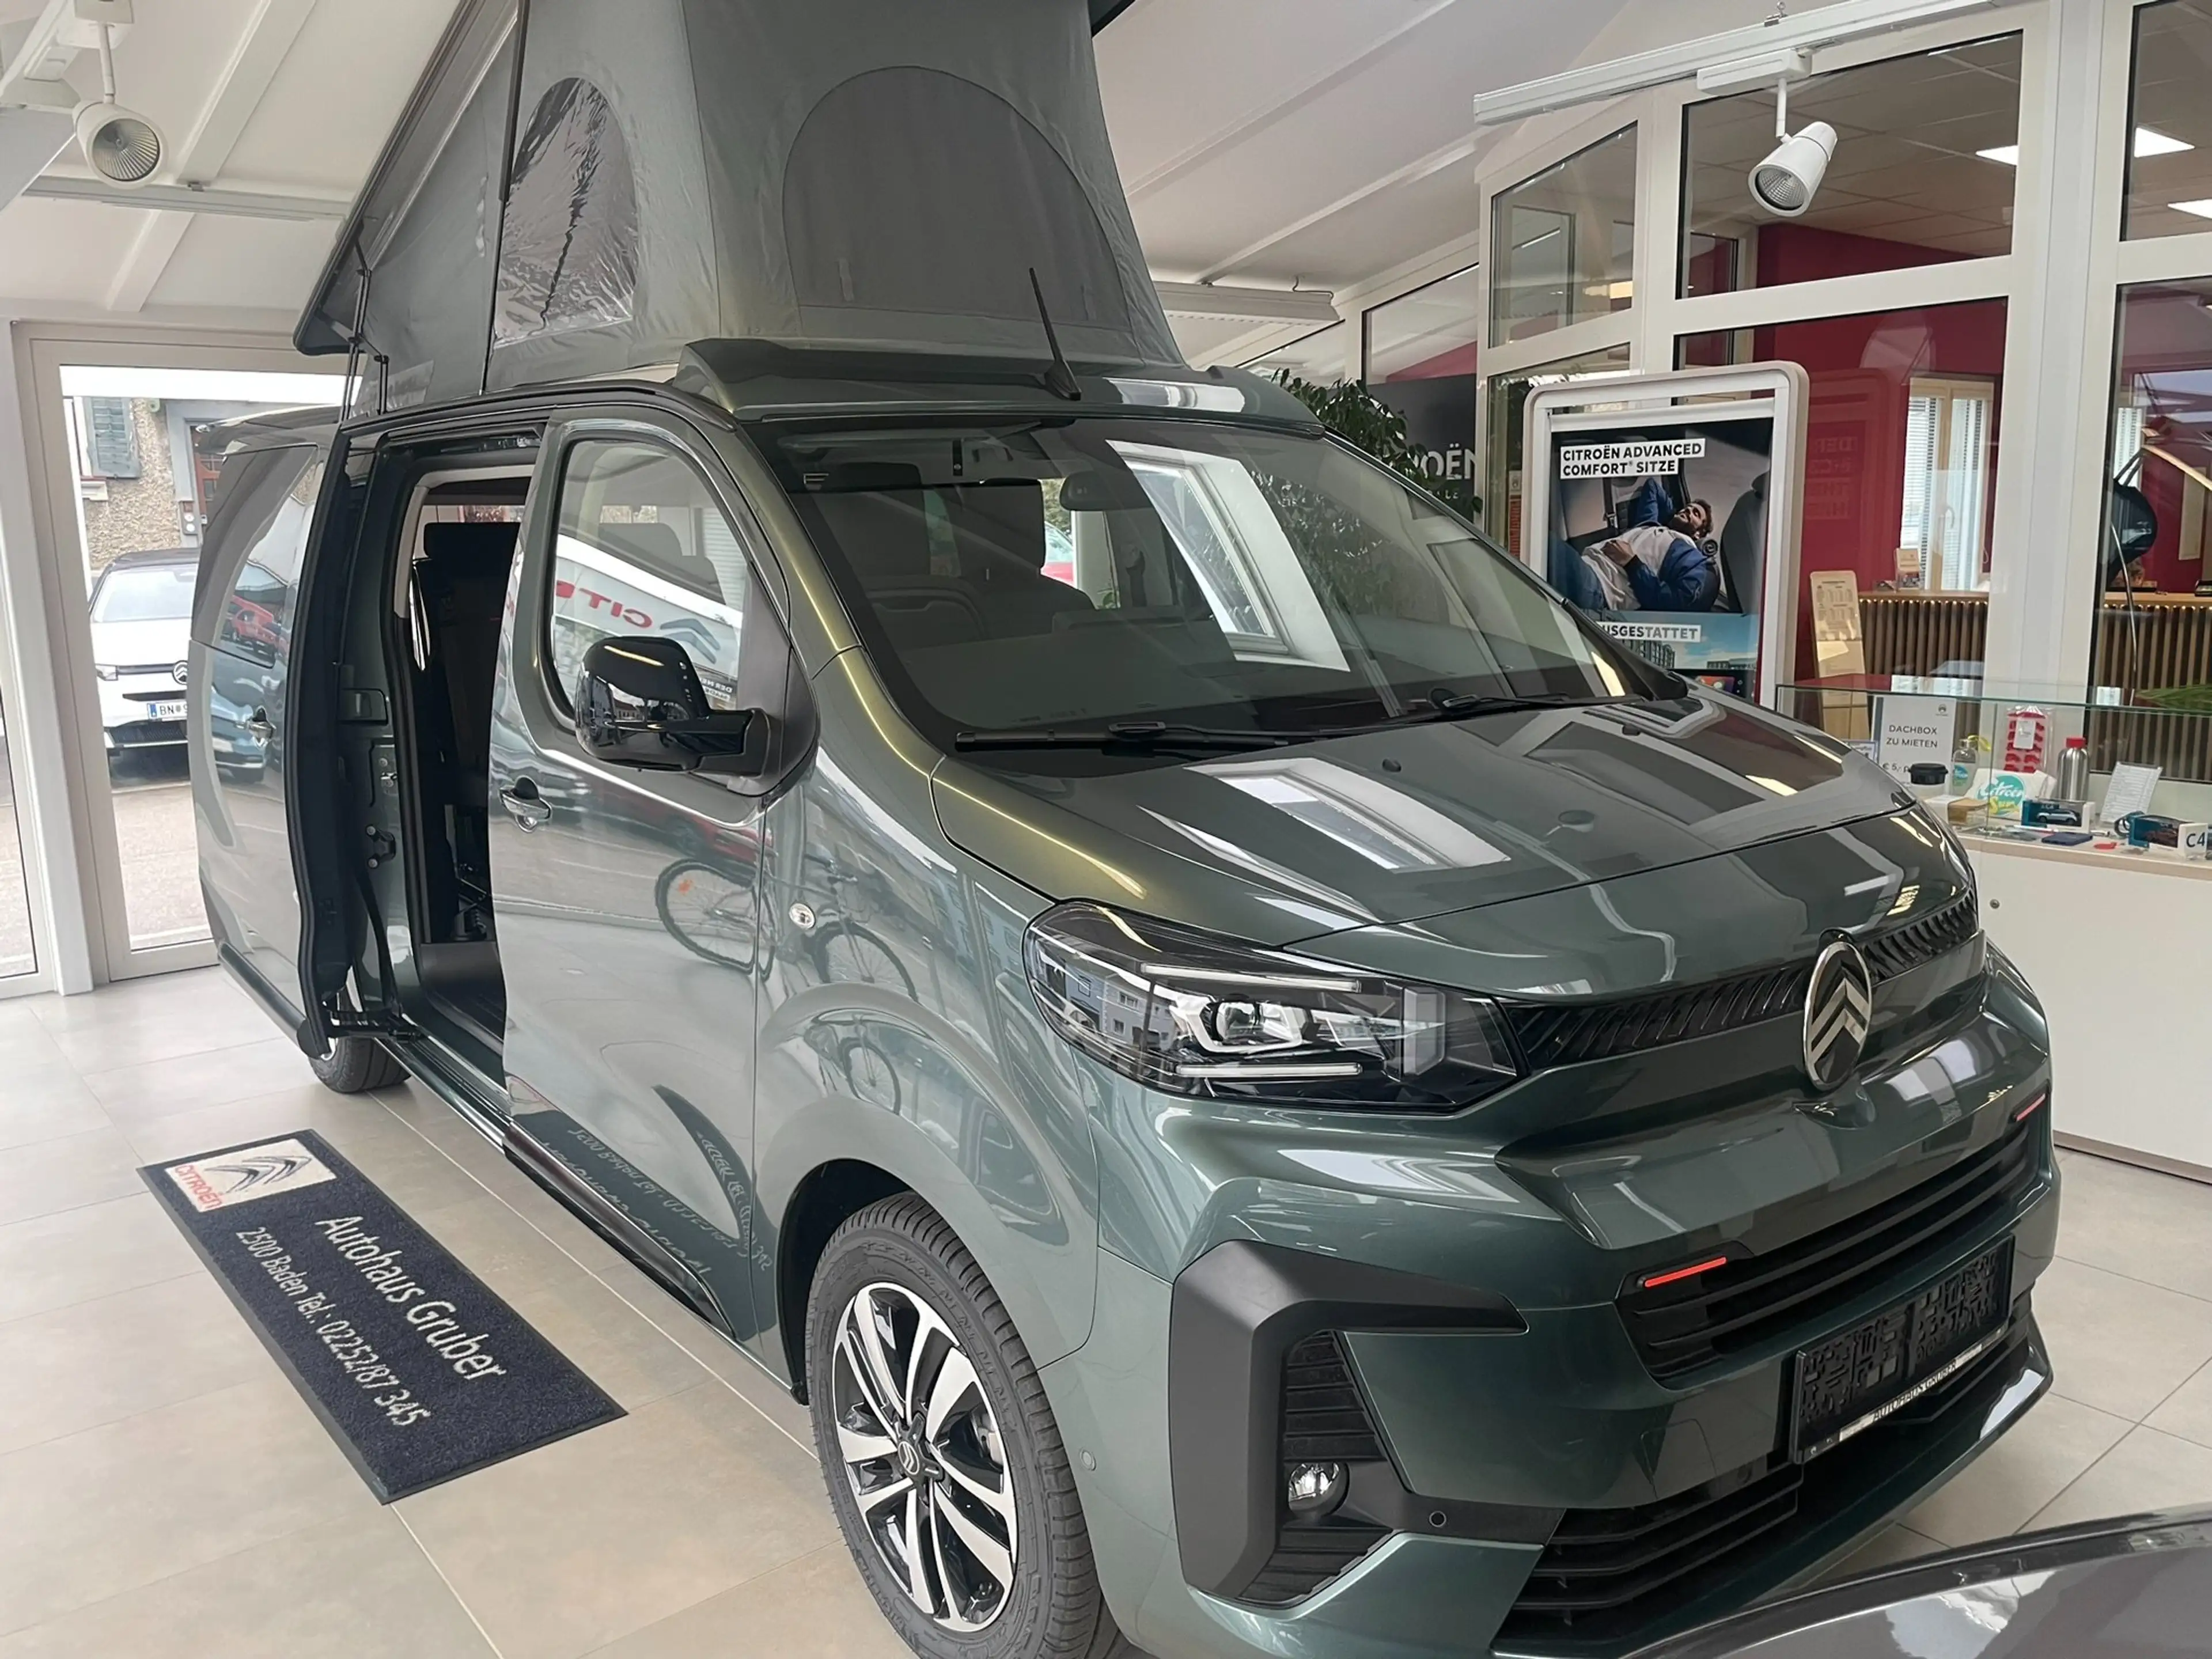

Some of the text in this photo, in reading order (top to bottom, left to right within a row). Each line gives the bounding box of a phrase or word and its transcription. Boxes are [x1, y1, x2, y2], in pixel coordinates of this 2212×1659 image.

[1563, 443, 1702, 461] CITROËN ADVANCED
[1637, 460, 1675, 473] SITZE
[1888, 724, 1938, 735] DACHBOX
[1885, 737, 1938, 749] ZU MIETEN
[2186, 831, 2205, 848] C4
[314, 1215, 507, 1381] Autohaus Gruber
[236, 1226, 283, 1259] 2500
[260, 1255, 308, 1297] Baden
[316, 1320, 400, 1389] 02252/87
[373, 1389, 431, 1426] 345
